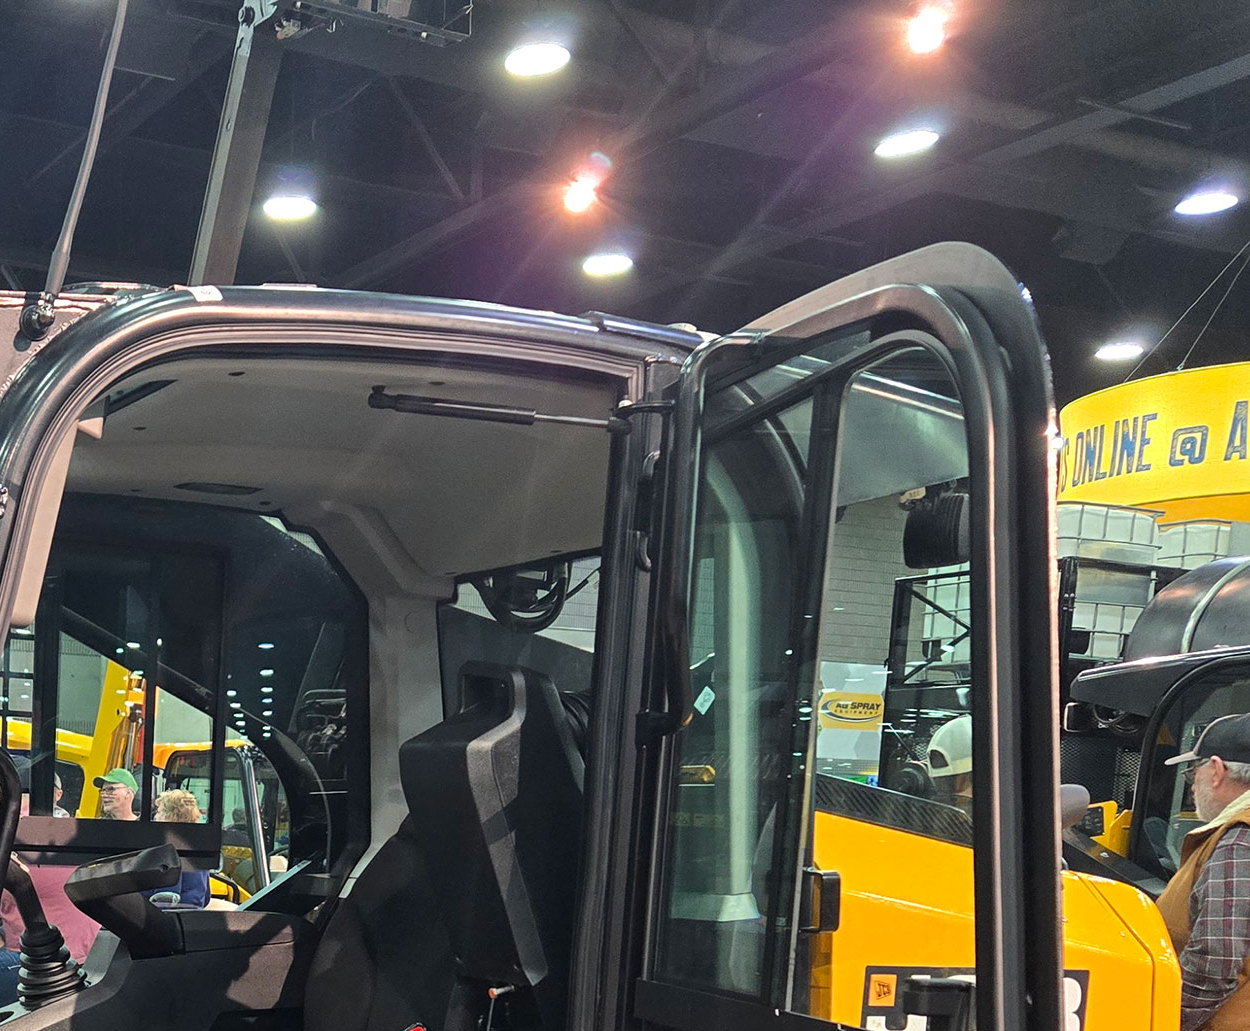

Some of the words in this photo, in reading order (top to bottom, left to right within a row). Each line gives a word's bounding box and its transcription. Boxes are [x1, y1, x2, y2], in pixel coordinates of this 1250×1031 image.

[1072, 413, 1158, 488] ONLINE
[1169, 425, 1209, 467] @
[850, 702, 881, 710] SPRAY
